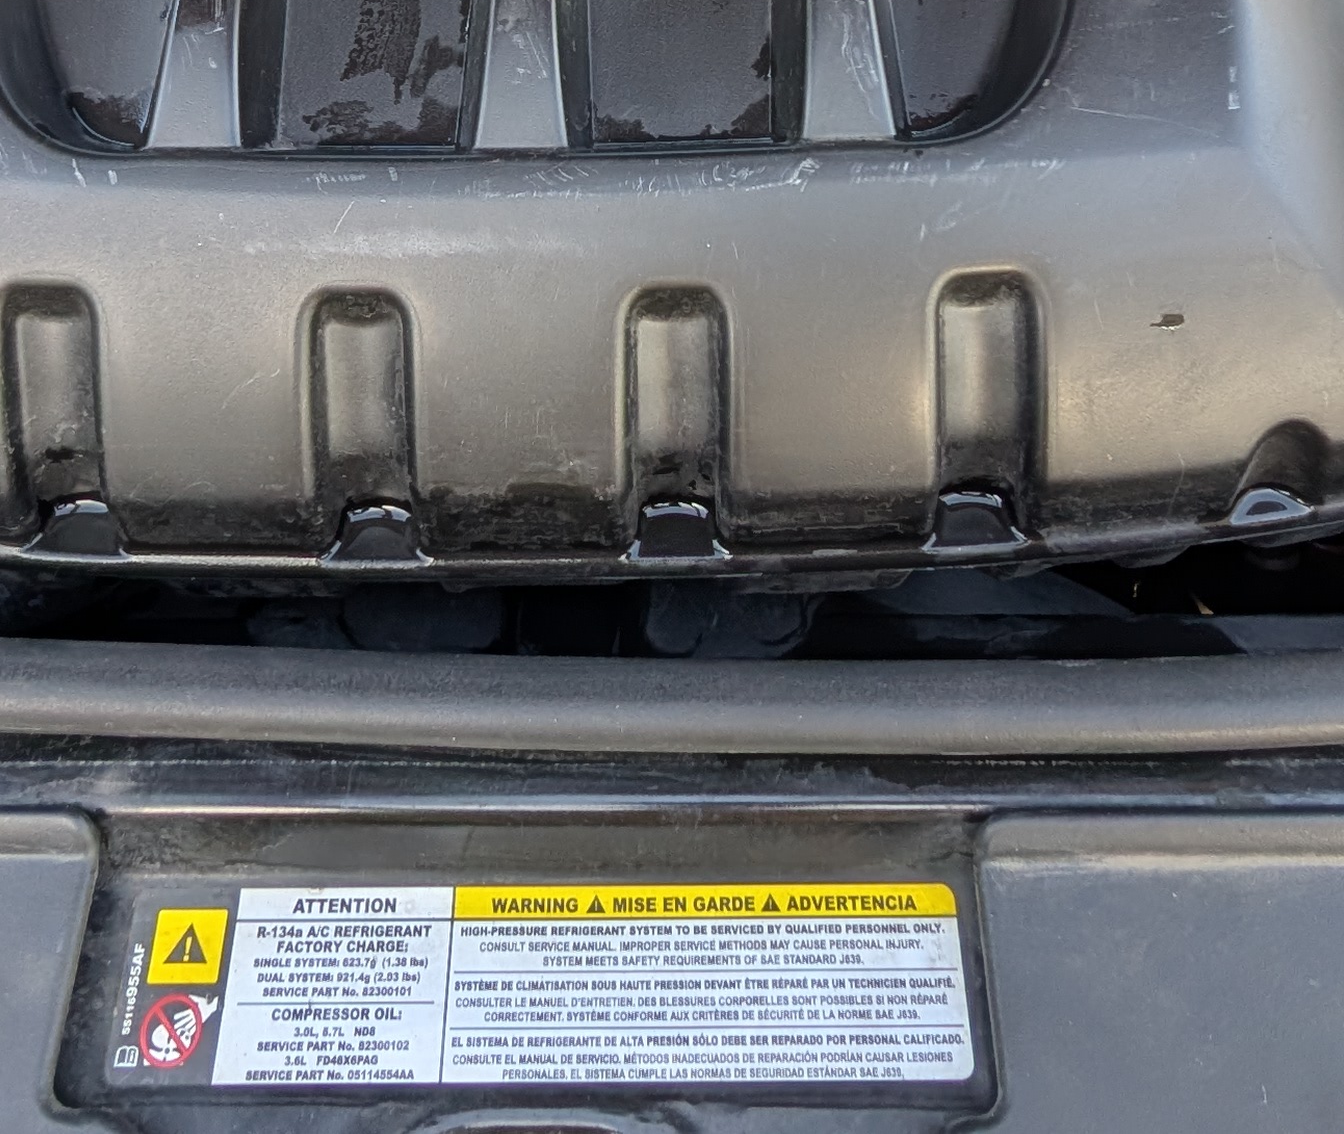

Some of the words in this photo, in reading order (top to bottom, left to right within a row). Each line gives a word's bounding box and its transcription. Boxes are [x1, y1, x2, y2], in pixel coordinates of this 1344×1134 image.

[293, 897, 396, 914] ATTENTION
[491, 897, 578, 914] WARNING
[612, 896, 656, 913] MISE
[662, 896, 686, 913] EN
[692, 896, 755, 913] GARDE
[786, 895, 916, 912] ADVERTENCIA
[257, 925, 303, 938] R-134a
[306, 925, 330, 938] A/C
[334, 924, 432, 938] REFRIGERANT
[460, 926, 547, 937] HIGH-PRESSURE
[550, 925, 626, 937] REFRIGERANT
[629, 925, 672, 937] SYSTEM
[674, 925, 690, 937] TO
[693, 925, 707, 937] BE
[710, 924, 764, 936] SERVICED
[766, 924, 782, 936] BY
[784, 924, 842, 936] QUALIFIED
[845, 923, 910, 936] PERSONNEL
[912, 923, 945, 936] ONLY.
[276, 940, 342, 954] FACTORY
[346, 940, 408, 954] CHARGE:
[479, 942, 525, 953] CONSULT
[528, 942, 570, 953] SERVICE
[619, 941, 671, 952] IMPROPER
[673, 941, 716, 952] SERVICE
[718, 940, 767, 952] METHODS
[769, 940, 790, 951] MAY
[792, 940, 826, 951] CAUSE
[829, 939, 884, 951] PERSONAL
[885, 939, 924, 951] INJURY.
[253, 958, 291, 968] SINGLE
[294, 958, 340, 968] SYSTEM:
[381, 957, 407, 968] (1.38
[409, 957, 428, 968] lbs)
[542, 956, 582, 967] SYSTEM
[585, 956, 618, 967] MEETS
[621, 955, 660, 967] SAFETY
[662, 955, 741, 967] REQUIREMENTS
[743, 955, 757, 966] OF
[760, 955, 780, 966] SAE
[782, 954, 836, 966] STANDARD
[256, 973, 285, 984] DUAL
[288, 973, 334, 984] SYSTEM:
[336, 972, 370, 984] 921.4g
[401, 972, 420, 984] lbs)
[500, 979, 513, 991] DE
[515, 978, 588, 991] CLIMATISATION
[591, 978, 617, 991] SOUS
[619, 978, 651, 991] HAUTE
[653, 978, 701, 991] PRESSION
[703, 977, 742, 990] DEVANT
[810, 977, 829, 990] PAR
[831, 977, 846, 990] UN
[847, 976, 906, 990] TECHNICIEN
[262, 987, 308, 997] SERVICE
[311, 987, 339, 997] PART
[341, 986, 359, 997] No.
[361, 986, 411, 997] 82300101
[455, 997, 512, 1008] CONSULTER
[514, 996, 526, 1008] LE
[528, 996, 568, 1008] MANUEL
[637, 995, 656, 1007] DES
[658, 995, 716, 1007] BLESSURES
[718, 995, 789, 1007] CORPORELLES
[791, 994, 818, 1006] SONT
[819, 994, 873, 1006] POSSIBLES
[875, 994, 884, 1006] SI
[886, 993, 908, 1006] NON
[271, 1008, 370, 1021] COMPRESSOR
[374, 1008, 402, 1021] OIL:
[613, 1010, 668, 1022] CONFORME
[669, 1010, 690, 1022] AUX
[741, 1009, 754, 1021] DE
[806, 1009, 820, 1021] DE
[822, 1009, 835, 1021] LA
[837, 1008, 872, 1021] NORME
[874, 1008, 894, 1021] SAE
[322, 1027, 345, 1038] 5.7L
[256, 1041, 304, 1051] SERVICE
[306, 1041, 335, 1051] PART
[337, 1040, 355, 1051] No.
[358, 1040, 409, 1051] 82300102
[451, 1036, 464, 1048] EL
[466, 1036, 509, 1048] SISTEMA
[511, 1036, 524, 1048] DE
[526, 1035, 601, 1048] REFRIGERANTE
[604, 1035, 617, 1048] DE
[619, 1035, 644, 1047] ALTA
[720, 1034, 747, 1047] DEBE
[749, 1034, 769, 1047] SER
[771, 1034, 823, 1046] REPARADO
[826, 1034, 846, 1046] POR
[848, 1034, 901, 1046] PERSONAL
[903, 1033, 964, 1046] CALIFICADO.
[284, 1056, 307, 1066] 3.6L
[452, 1053, 502, 1065] CONSULTE
[504, 1053, 516, 1065] EL
[518, 1052, 558, 1065] MANUAL
[560, 1052, 573, 1065] DE
[671, 1051, 740, 1064] INADECUADOS
[742, 1051, 755, 1064] DE
[864, 1050, 904, 1063] CAUSAR
[906, 1050, 953, 1063] LESIONES
[245, 1070, 292, 1081] SERVICE
[295, 1070, 324, 1081] PART
[326, 1070, 344, 1081] No.
[570, 1069, 582, 1081] EL
[584, 1068, 626, 1081] SISTEMA
[627, 1068, 667, 1080] CUMPLE
[669, 1068, 688, 1080] LAS
[690, 1068, 731, 1080] NORMAS
[733, 1068, 747, 1080] DE
[749, 1068, 804, 1079] SEGURIDAD
[859, 1067, 879, 1079] SAE
